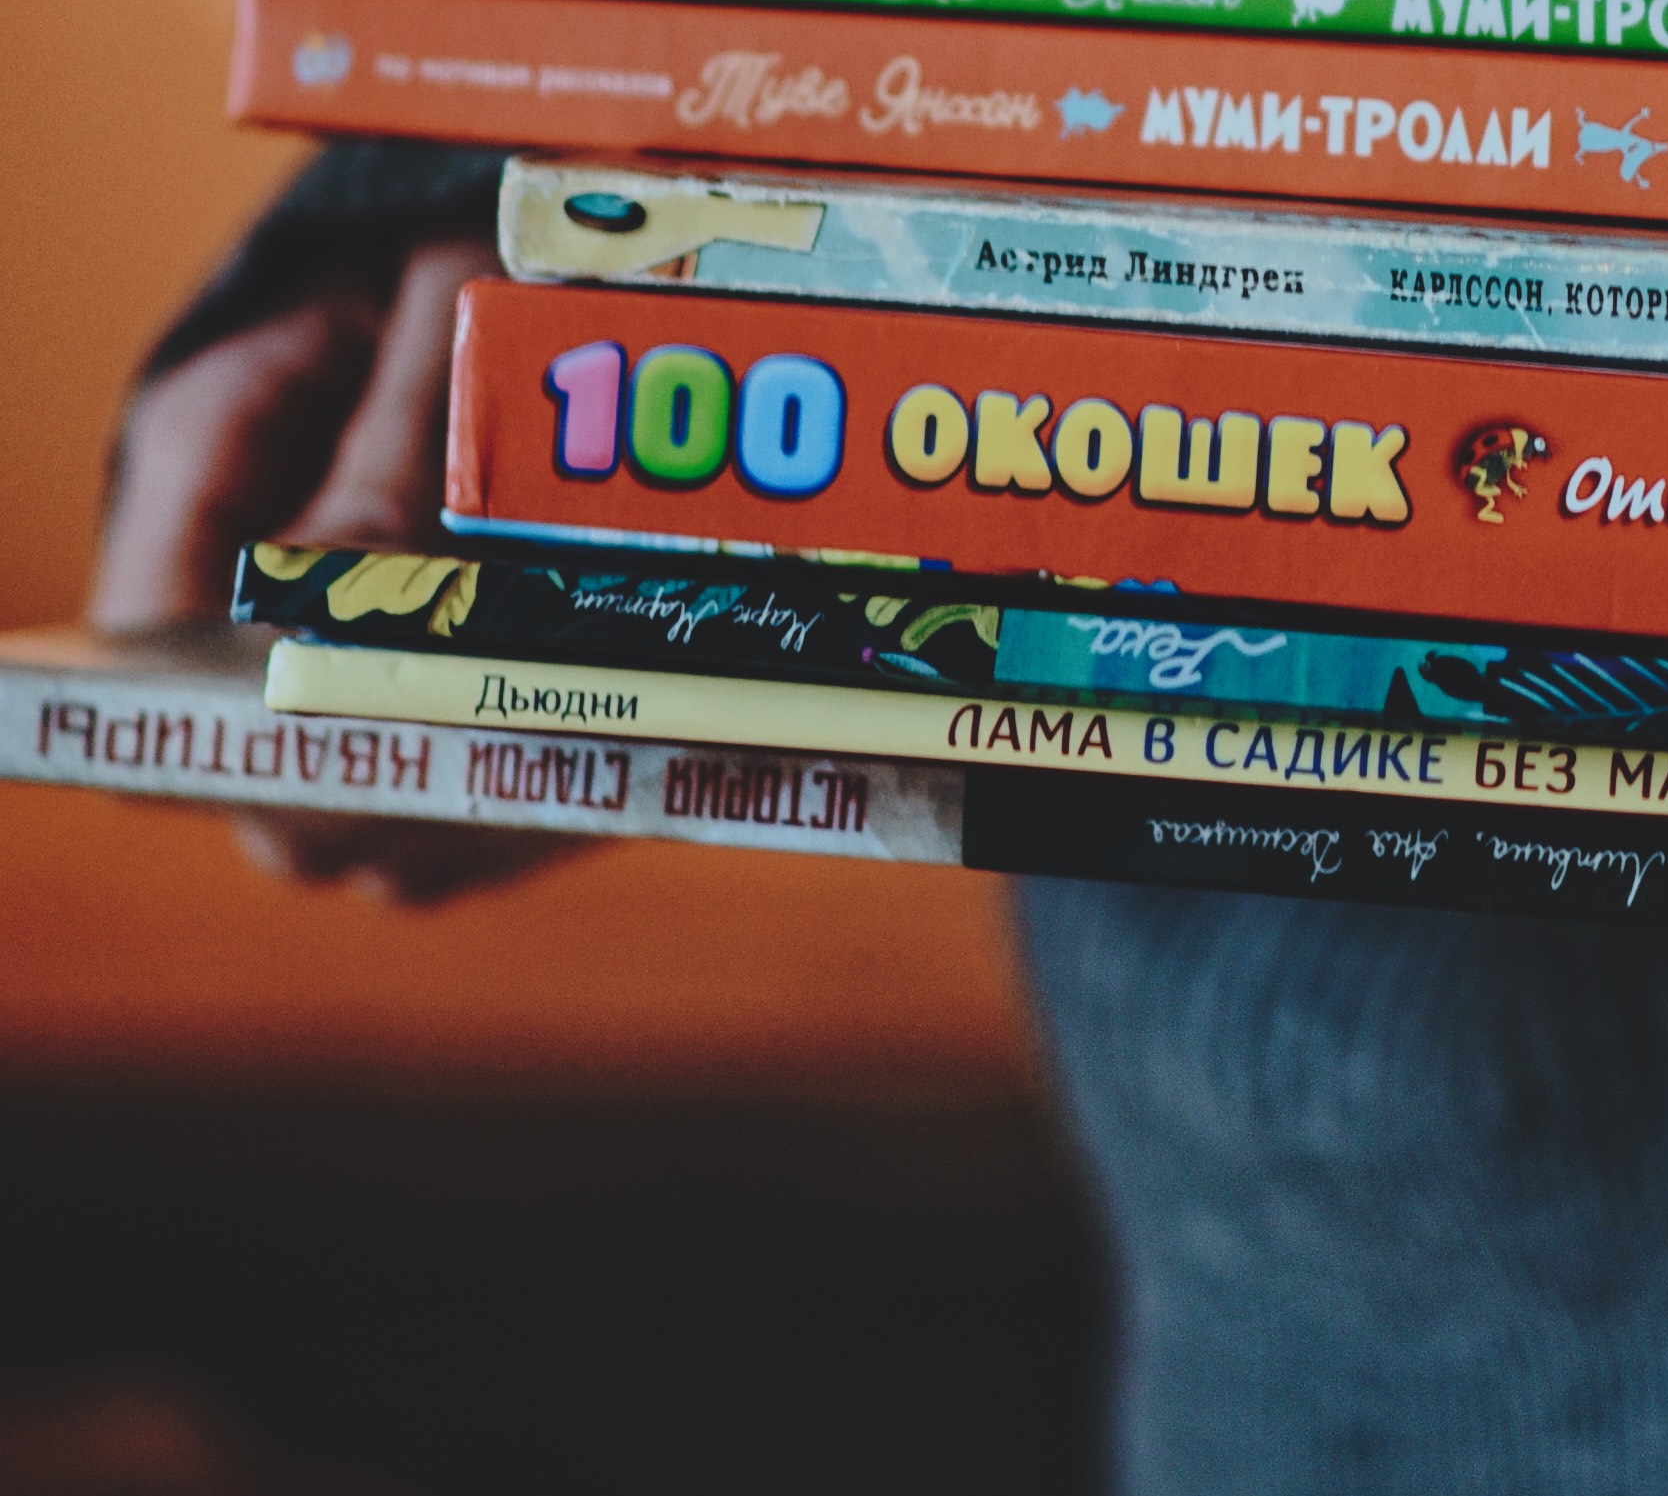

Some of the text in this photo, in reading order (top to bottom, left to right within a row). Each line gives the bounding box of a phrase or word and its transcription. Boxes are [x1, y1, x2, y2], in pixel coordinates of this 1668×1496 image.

[678, 50, 849, 128] Туве
[1140, 86, 1551, 169] МУМИ-ТРОЛЛИ
[1124, 251, 1305, 298] Линдгрен
[545, 340, 1411, 525] 100 ОКОШЕК
[571, 583, 826, 650] Марк Мартин
[474, 675, 637, 722] Дьюдни
[38, 702, 865, 832] ИСТОРИЯ СТАРОЙ КВАРТИРЫ
[948, 703, 1111, 758] ЛАМА
[1144, 716, 1175, 764] В
[1205, 721, 1445, 784] САДИКЕ
[1476, 740, 1576, 794] БЕЗ
[1148, 819, 1341, 883] Десницкая
[1366, 826, 1448, 880] Аня
